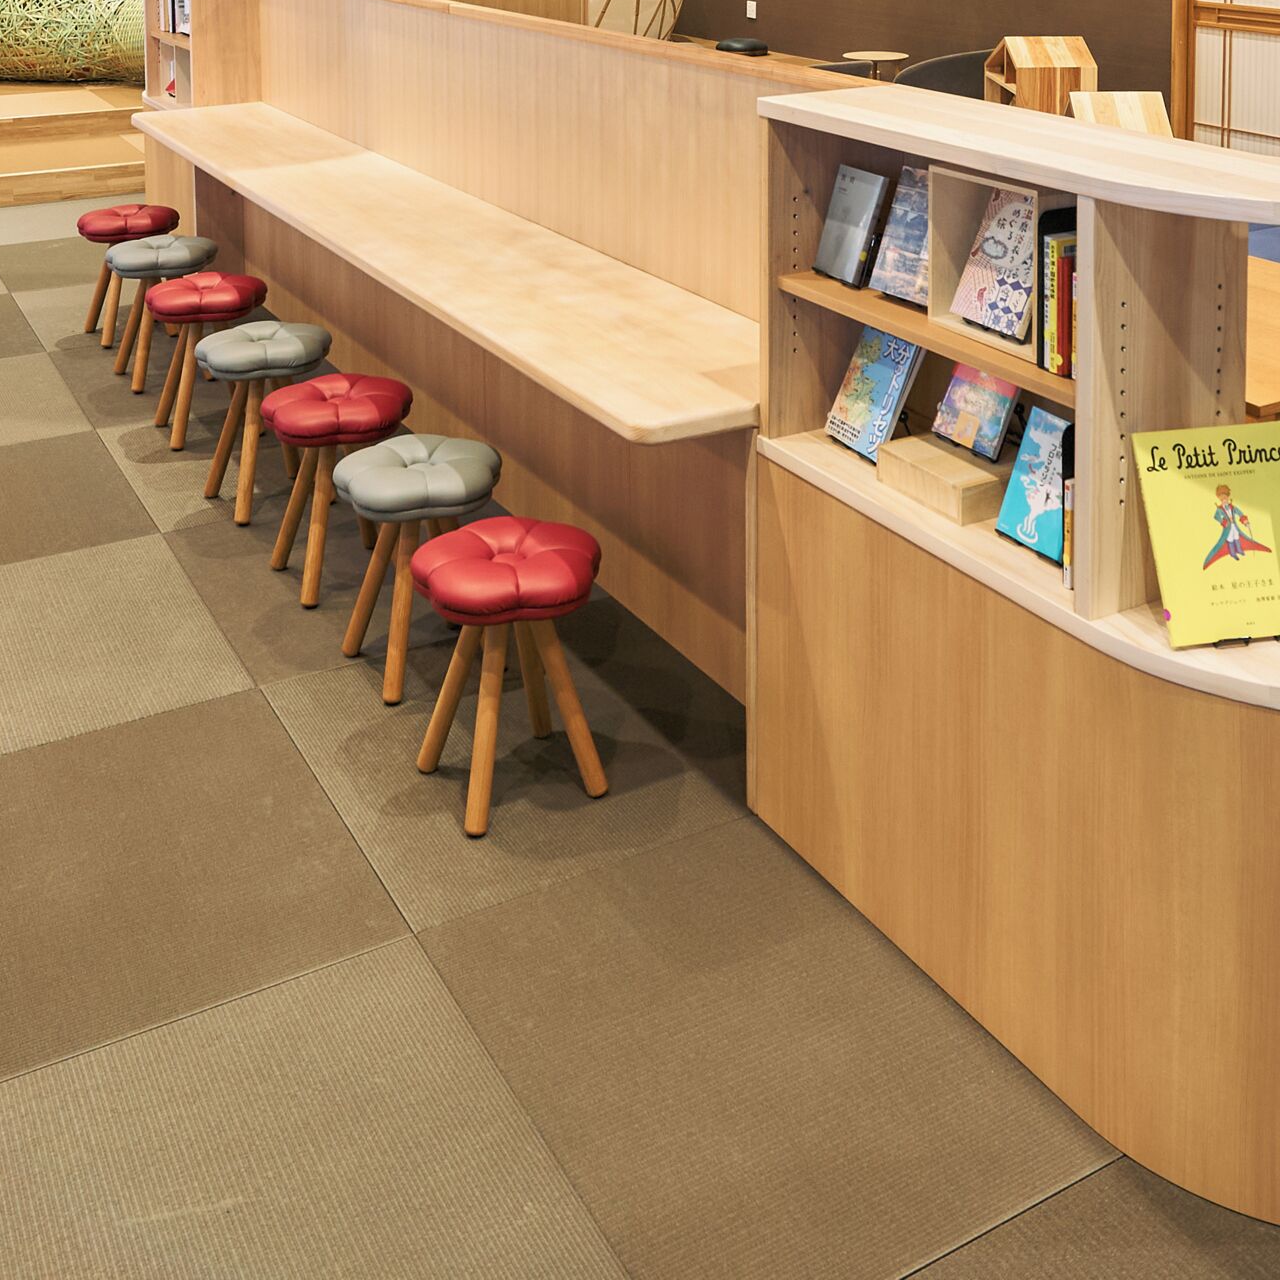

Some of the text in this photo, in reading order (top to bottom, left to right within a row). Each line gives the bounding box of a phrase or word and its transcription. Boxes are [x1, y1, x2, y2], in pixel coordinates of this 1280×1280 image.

[883, 338, 910, 365] 大分
[1147, 446, 1168, 472] Le
[1172, 443, 1219, 470] Petit
